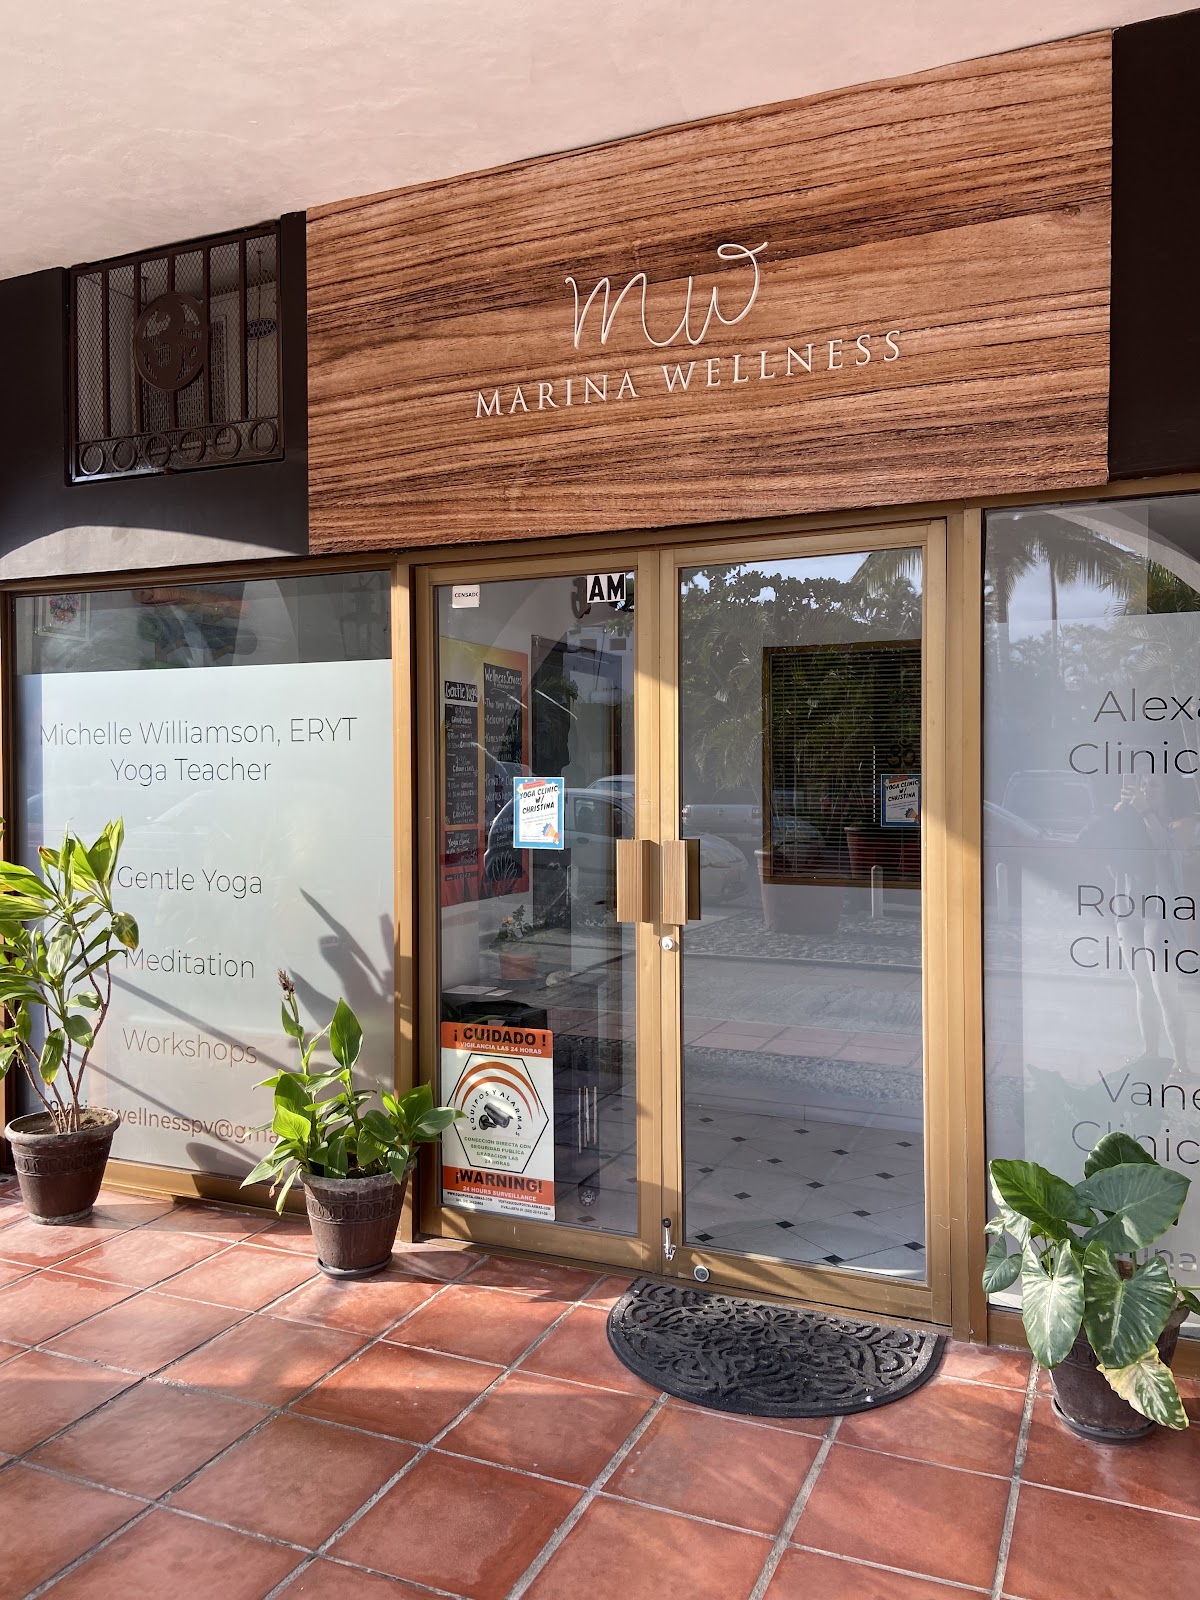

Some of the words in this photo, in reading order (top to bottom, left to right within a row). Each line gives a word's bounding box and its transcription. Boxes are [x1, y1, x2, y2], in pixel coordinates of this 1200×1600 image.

[475, 369, 640, 419] MARINA
[661, 330, 902, 393] WELLNESS
[588, 573, 625, 601] AM
[1093, 688, 1200, 722] Alex
[40, 721, 132, 746] Michelle
[139, 720, 281, 746] Williamson,
[290, 717, 357, 742] ERYT
[110, 758, 167, 787] Yoga
[174, 756, 272, 781] Teacher
[1069, 741, 1198, 775] Clinic
[519, 790, 536, 800] YOGA
[537, 785, 558, 796] CLINIC
[522, 801, 555, 815] CHRISTINA
[117, 865, 195, 891] Gentle
[201, 868, 262, 899] Yoga
[1077, 885, 1196, 921] Rona
[125, 948, 255, 979] Meditation
[1070, 936, 1199, 975] Clinic
[122, 1027, 257, 1067] Workshops
[460, 1042, 496, 1051] VIGILANCIA
[497, 1044, 509, 1052] LAS
[520, 1047, 542, 1055] HORAS
[463, 1027, 536, 1046] CUIDADO
[1072, 1120, 1200, 1165] Cnic
[455, 1169, 543, 1194] ¡WARNING!
[471, 1187, 491, 1195] HOURS
[492, 1191, 537, 1202] SURVEILLANCE
